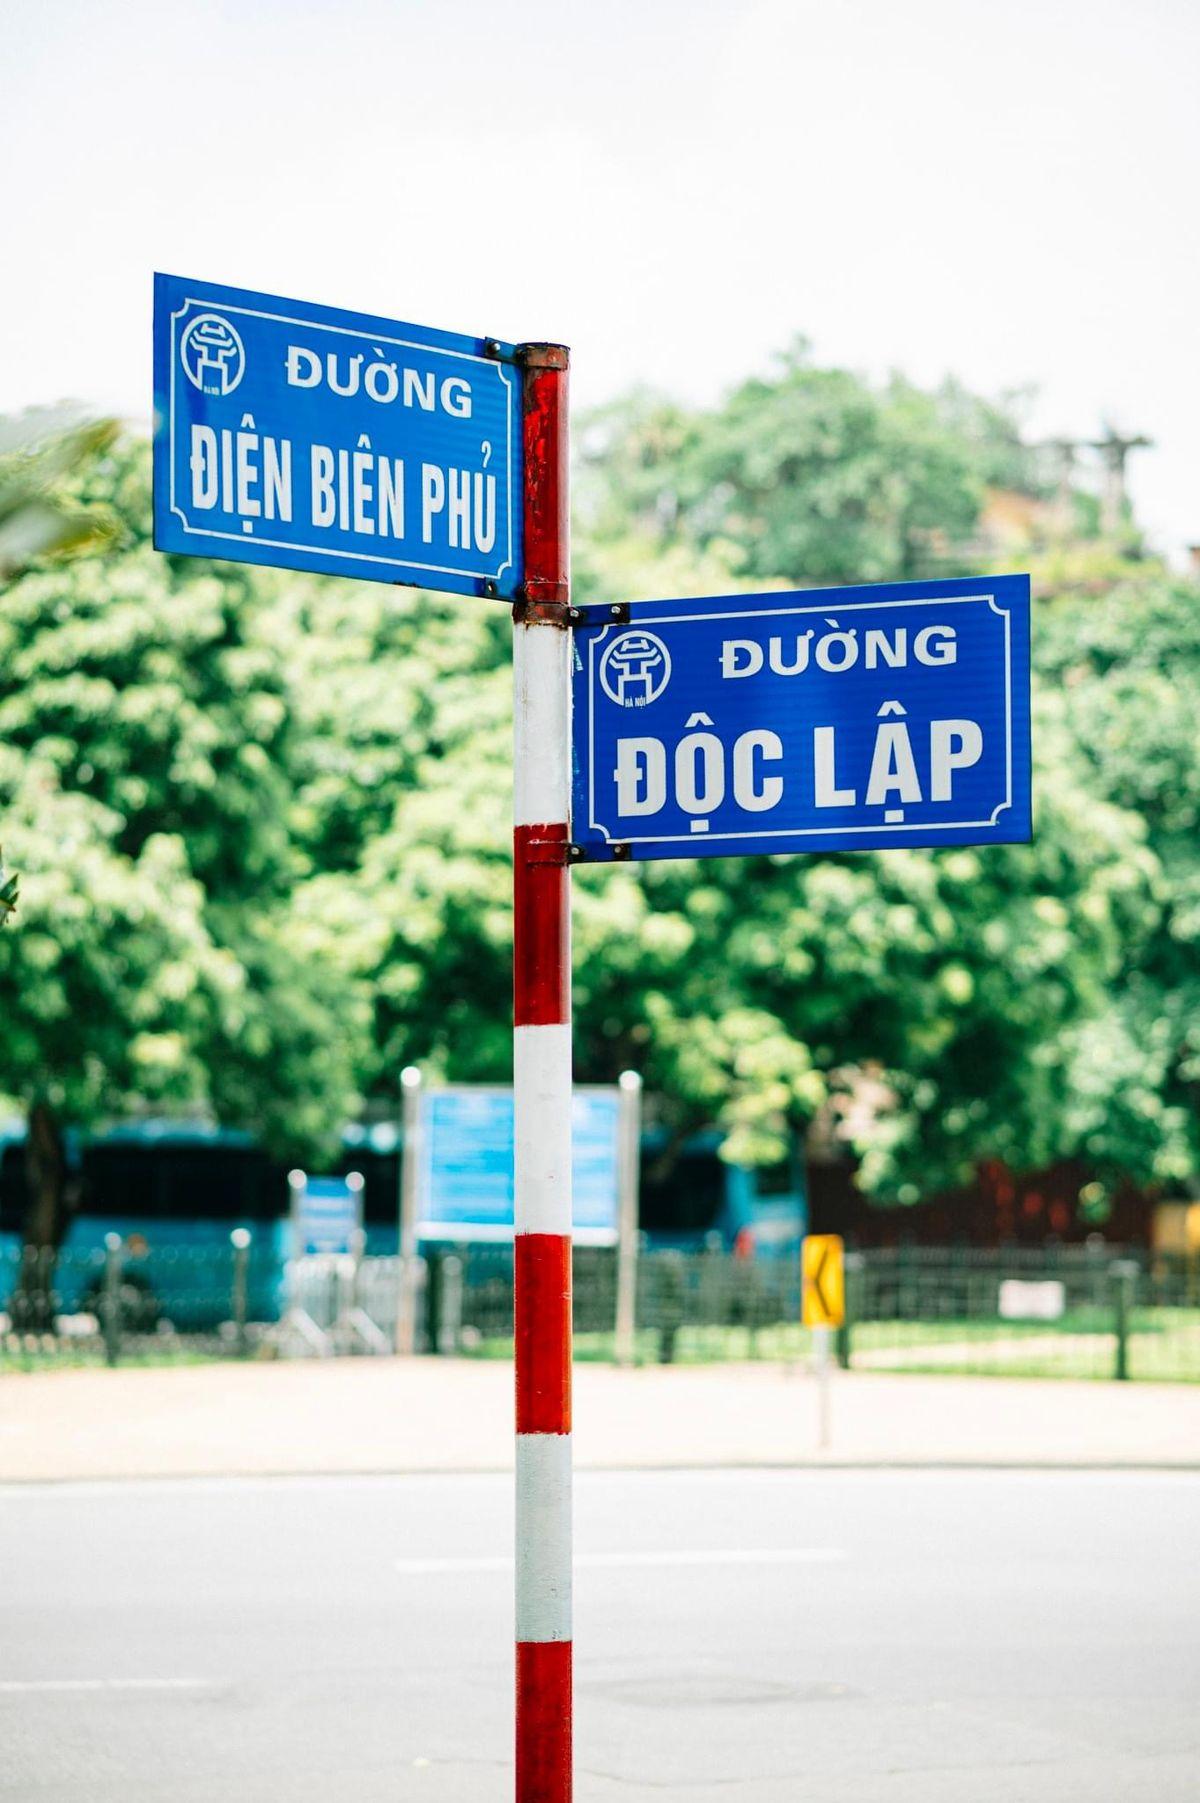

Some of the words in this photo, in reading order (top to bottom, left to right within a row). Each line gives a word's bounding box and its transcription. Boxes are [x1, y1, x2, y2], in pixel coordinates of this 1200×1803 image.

[284, 345, 472, 419] ĐƯỜNG
[190, 413, 292, 534] ĐIỆN
[311, 433, 404, 540] BIÊN
[421, 440, 496, 555] PHỦ
[719, 618, 957, 679] ĐƯỜNG
[613, 712, 784, 833] ĐỘC
[813, 700, 983, 824] LẬP
